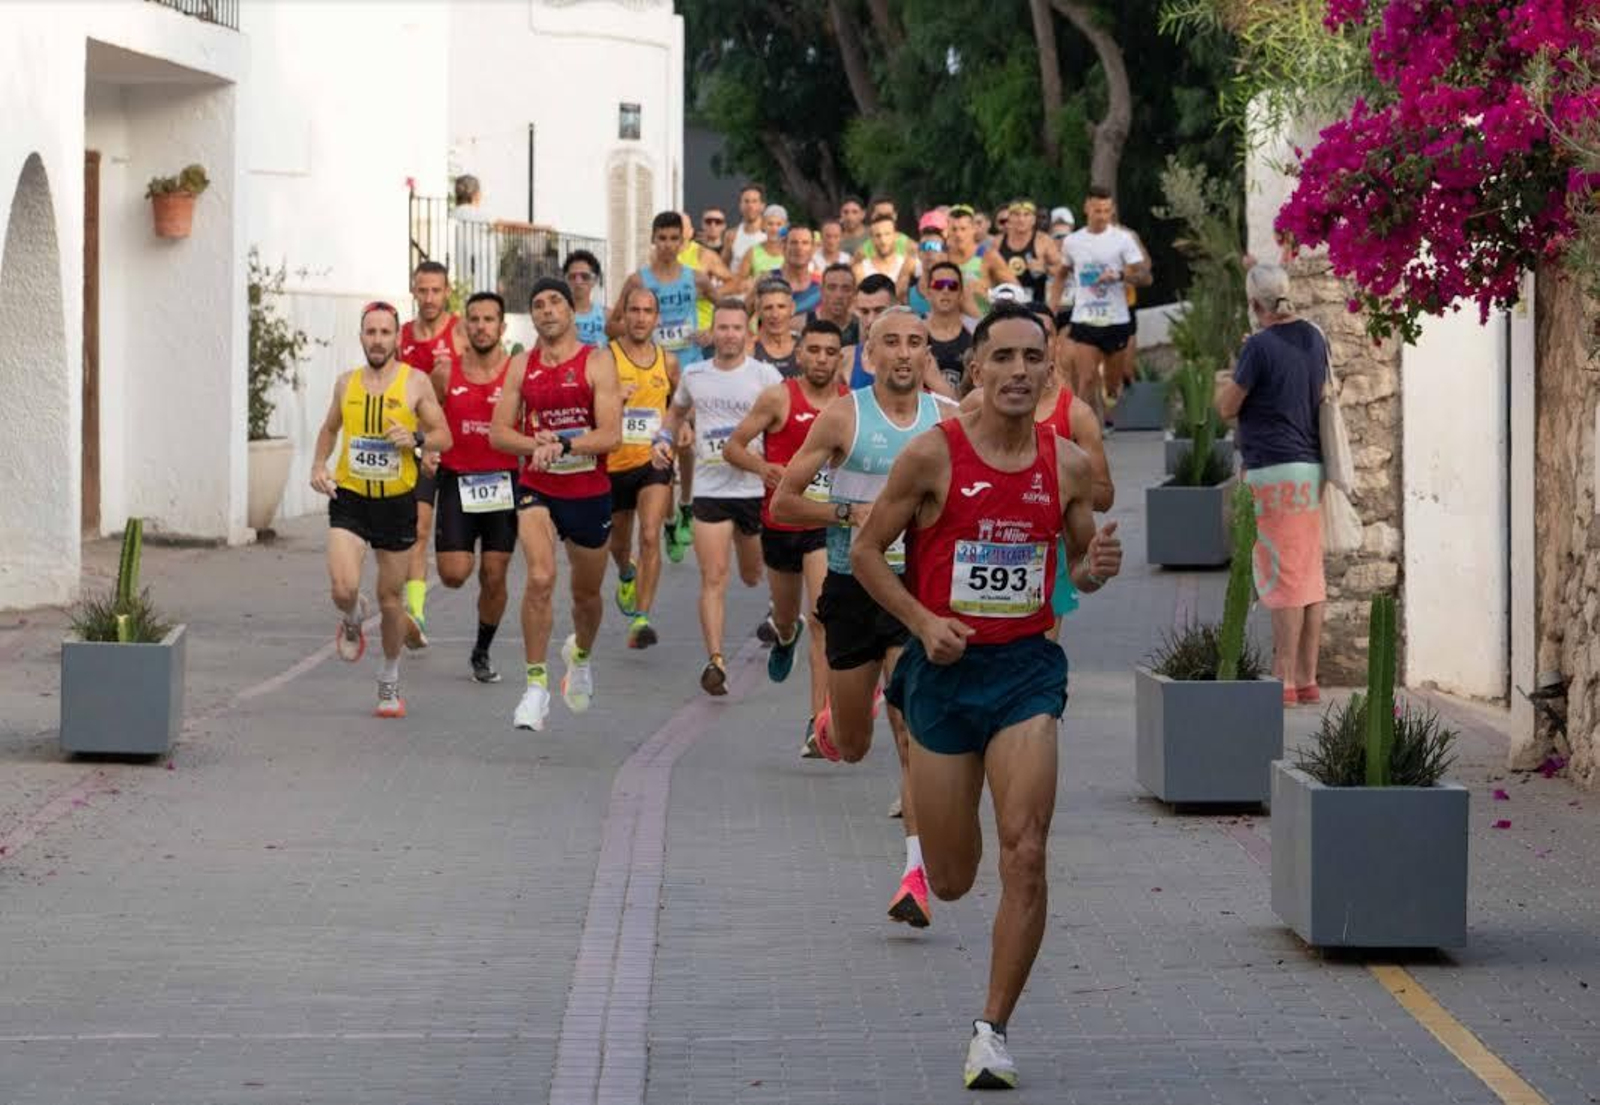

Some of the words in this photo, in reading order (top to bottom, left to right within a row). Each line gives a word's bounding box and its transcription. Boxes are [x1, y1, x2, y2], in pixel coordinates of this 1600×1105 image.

[654, 288, 691, 305] erja
[659, 327, 683, 339] 161
[627, 419, 647, 431] 85
[708, 439, 727, 453] 14
[355, 451, 389, 467] 485
[810, 472, 831, 488] 29
[468, 485, 499, 500] 107
[968, 565, 1028, 591] 593
